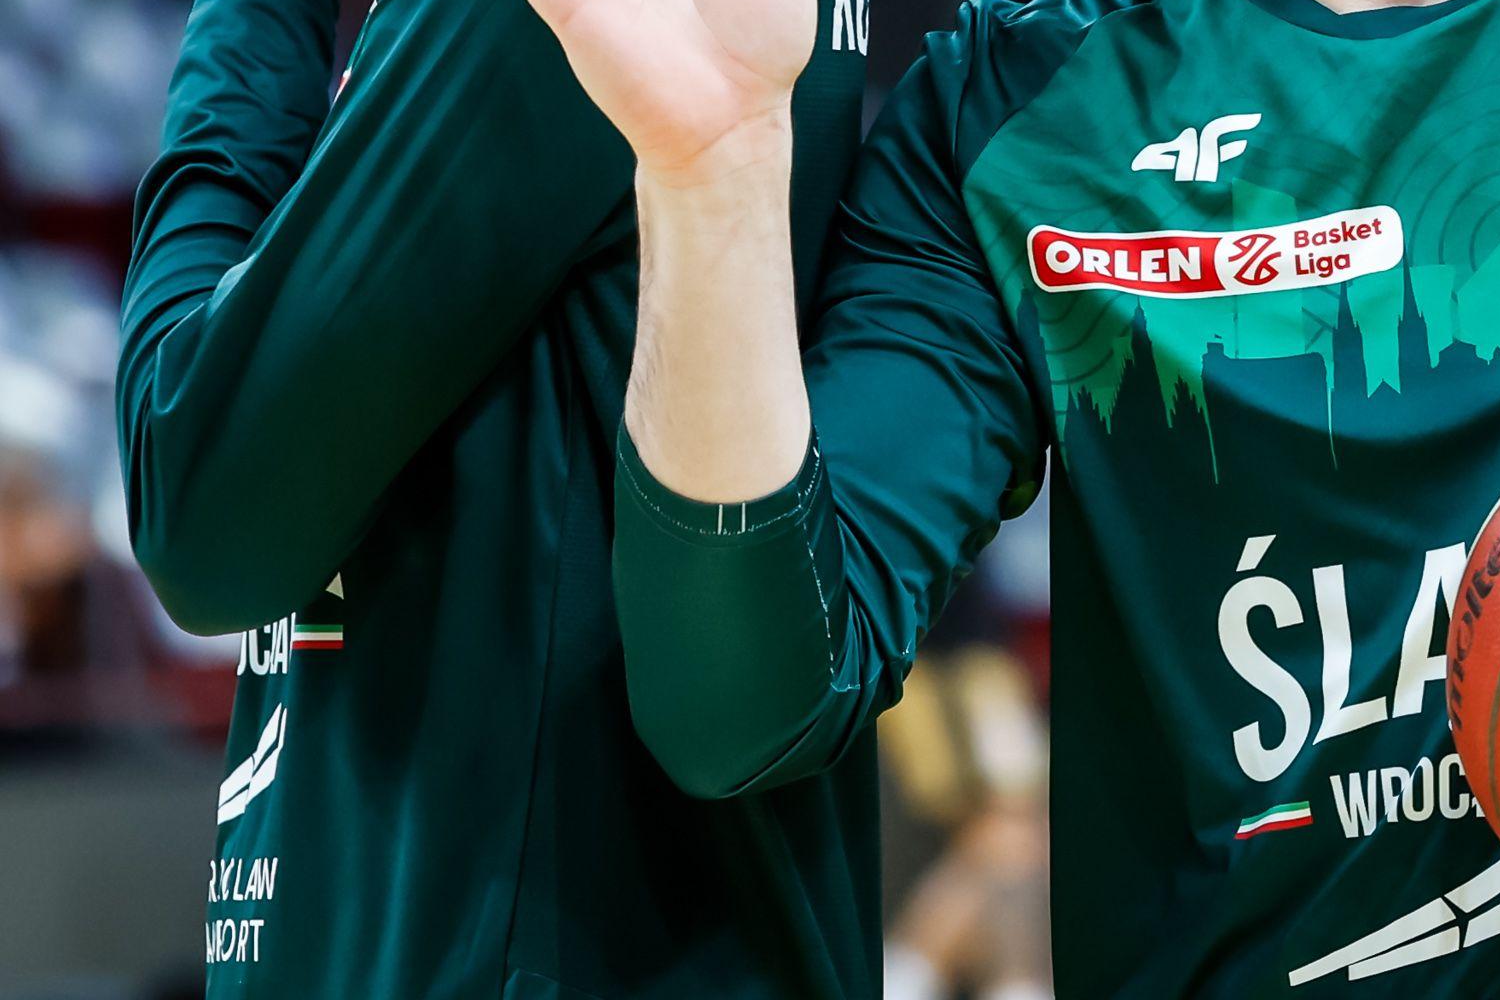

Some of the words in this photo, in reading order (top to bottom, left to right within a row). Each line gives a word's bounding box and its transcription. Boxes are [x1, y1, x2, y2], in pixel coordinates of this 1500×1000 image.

[1131, 113, 1262, 182] 4F
[1294, 218, 1382, 248] Basket
[1045, 240, 1202, 282] ORLEN
[1294, 252, 1351, 278] Liga
